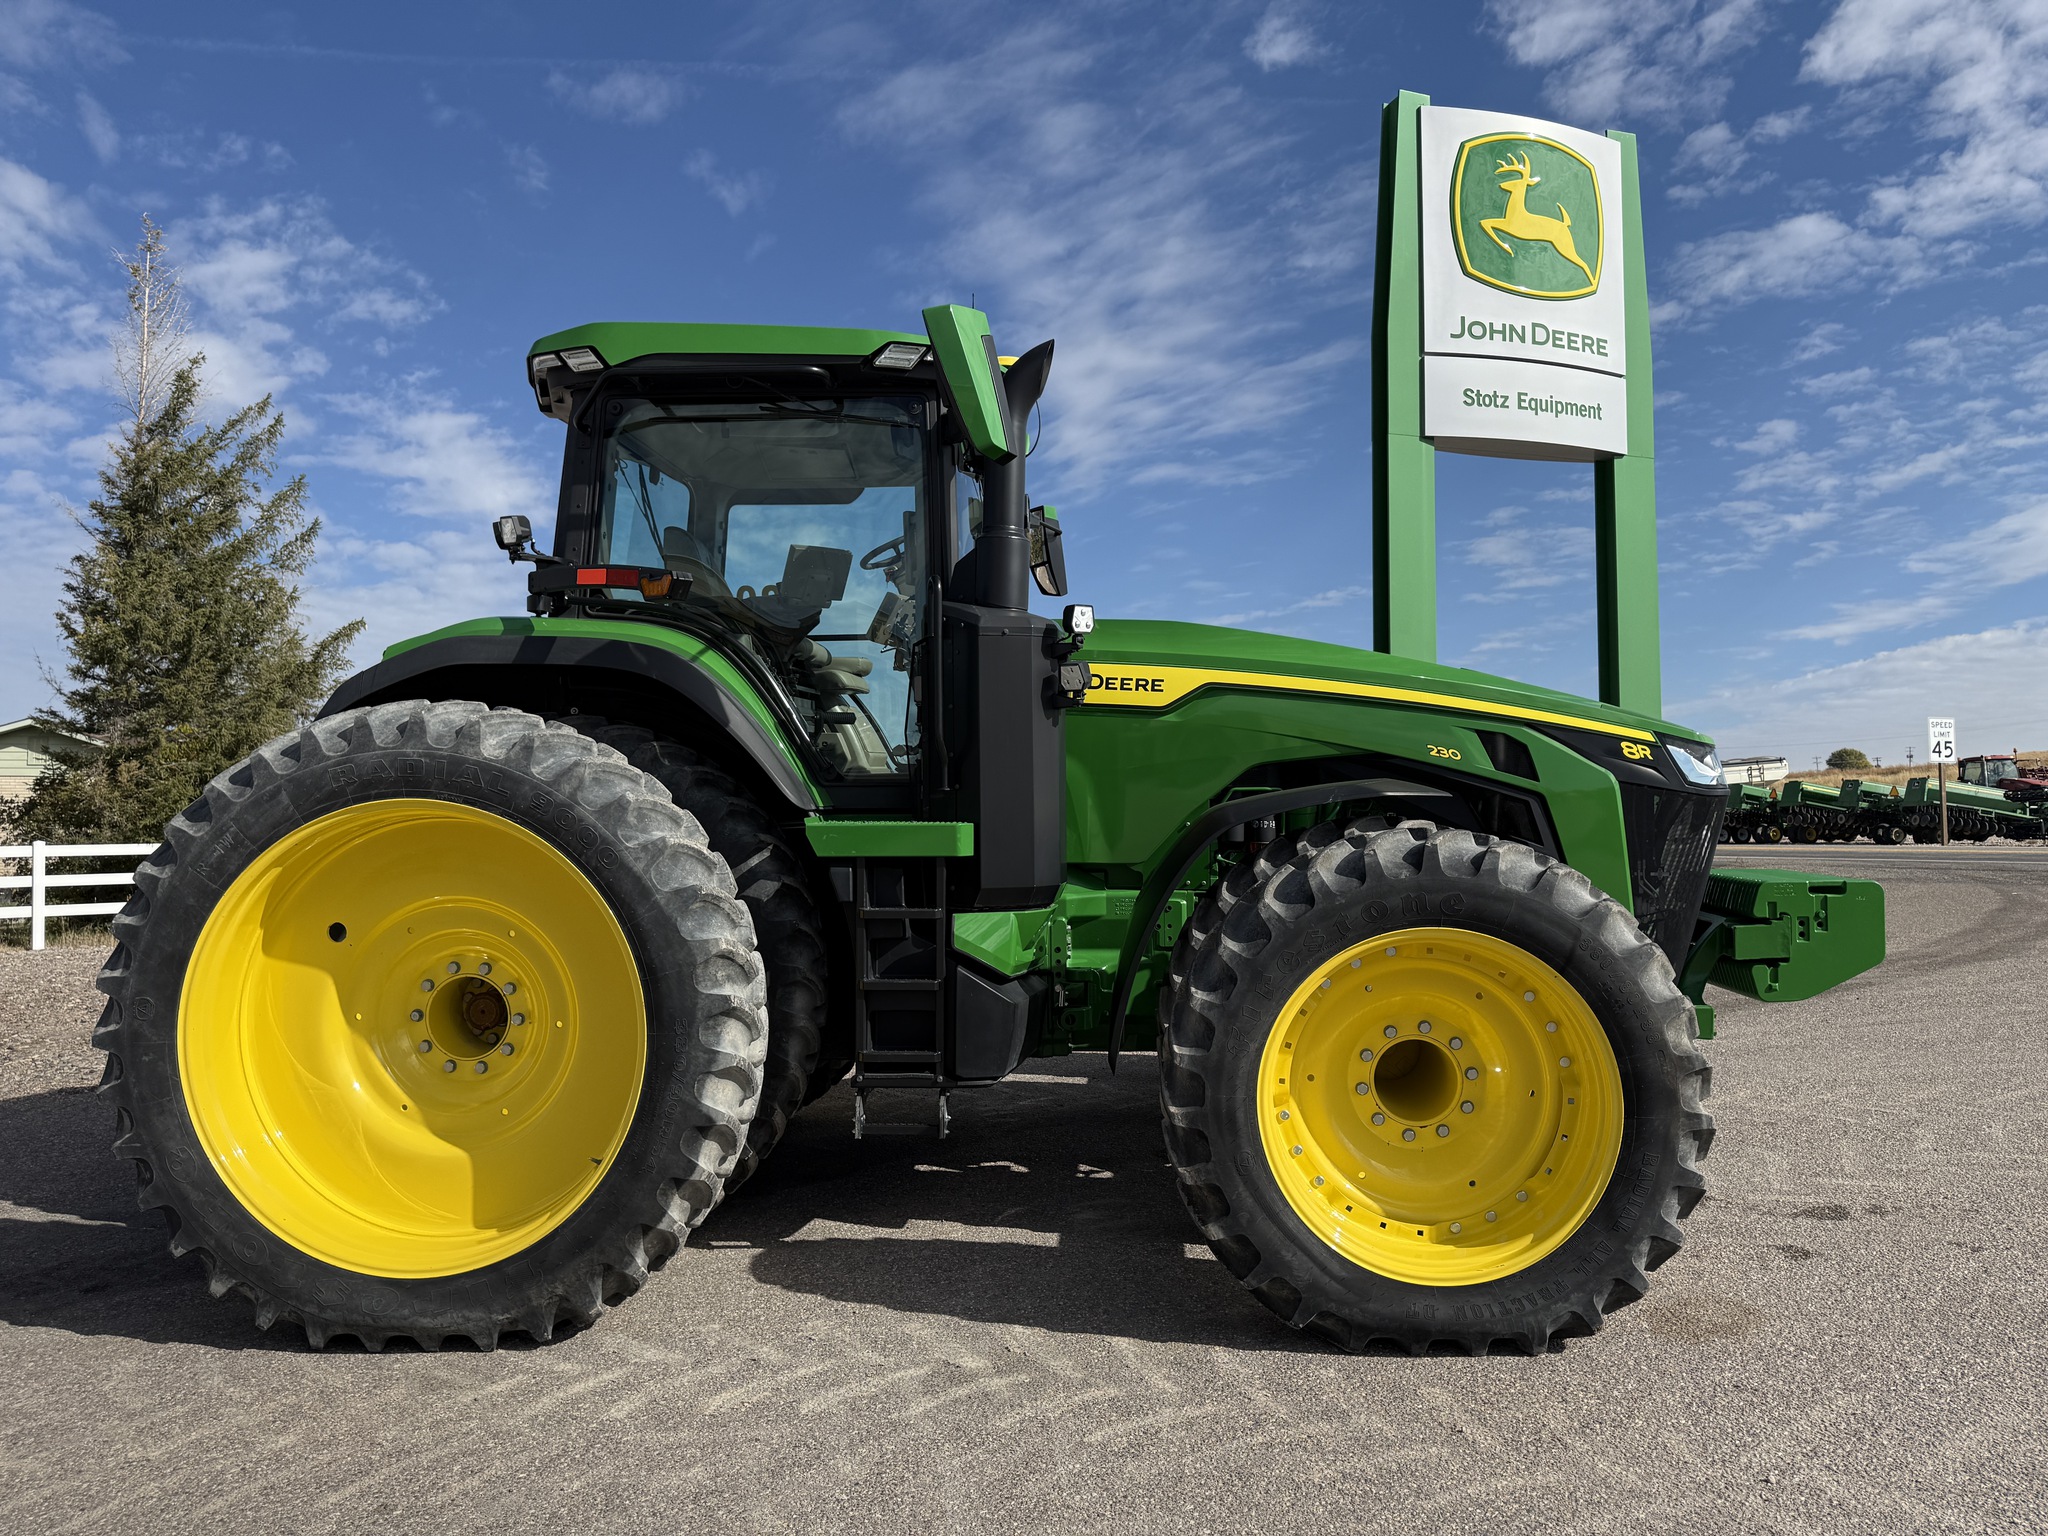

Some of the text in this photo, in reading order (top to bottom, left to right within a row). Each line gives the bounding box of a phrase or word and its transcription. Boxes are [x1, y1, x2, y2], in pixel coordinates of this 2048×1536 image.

[1450, 316, 1608, 357] JOHN DEERE
[1462, 388, 1602, 420] Stotz Equipment
[1088, 673, 1165, 692] DEERE
[1931, 721, 1953, 729] SPEED
[1426, 744, 1462, 761] 230
[1620, 741, 1654, 761] 8R
[1932, 740, 1953, 758] 45
[328, 757, 620, 870] RADIAL 9000
[1226, 891, 1467, 1060] Firestone
[1611, 1151, 1661, 1234] RADIAL
[1571, 1239, 1614, 1278] ALL
[1450, 1276, 1570, 1322] TRACTION
